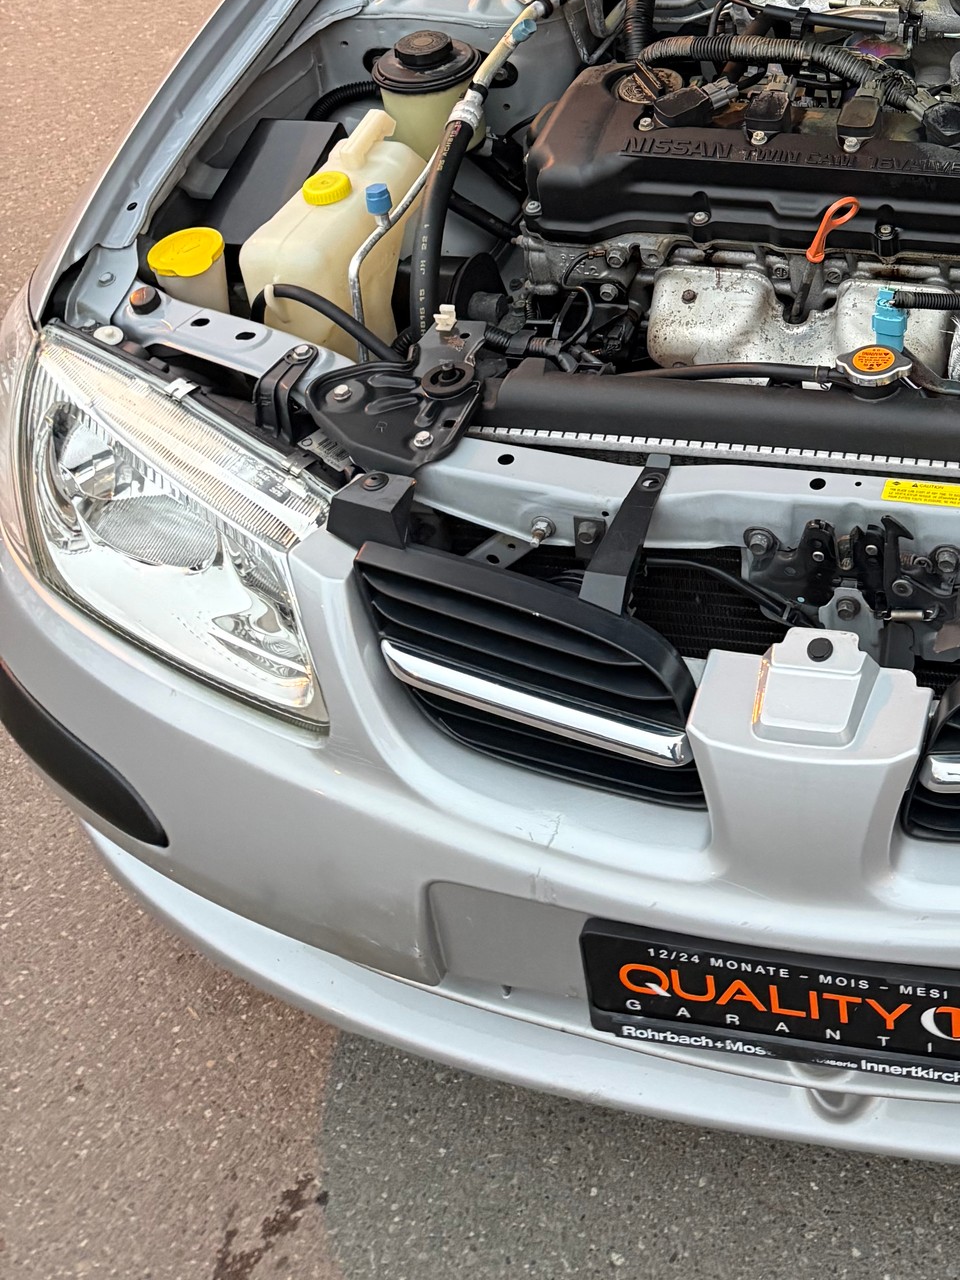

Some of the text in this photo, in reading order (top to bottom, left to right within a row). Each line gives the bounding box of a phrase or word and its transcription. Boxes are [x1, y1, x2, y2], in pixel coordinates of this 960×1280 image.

[621, 136, 733, 159] NISSAN
[743, 147, 799, 164] TWIN
[619, 963, 912, 1030] QUALITY
[647, 948, 700, 963] 12/24
[709, 957, 790, 978] MONATE
[818, 974, 870, 990] MOIS
[899, 985, 948, 1000] MESI
